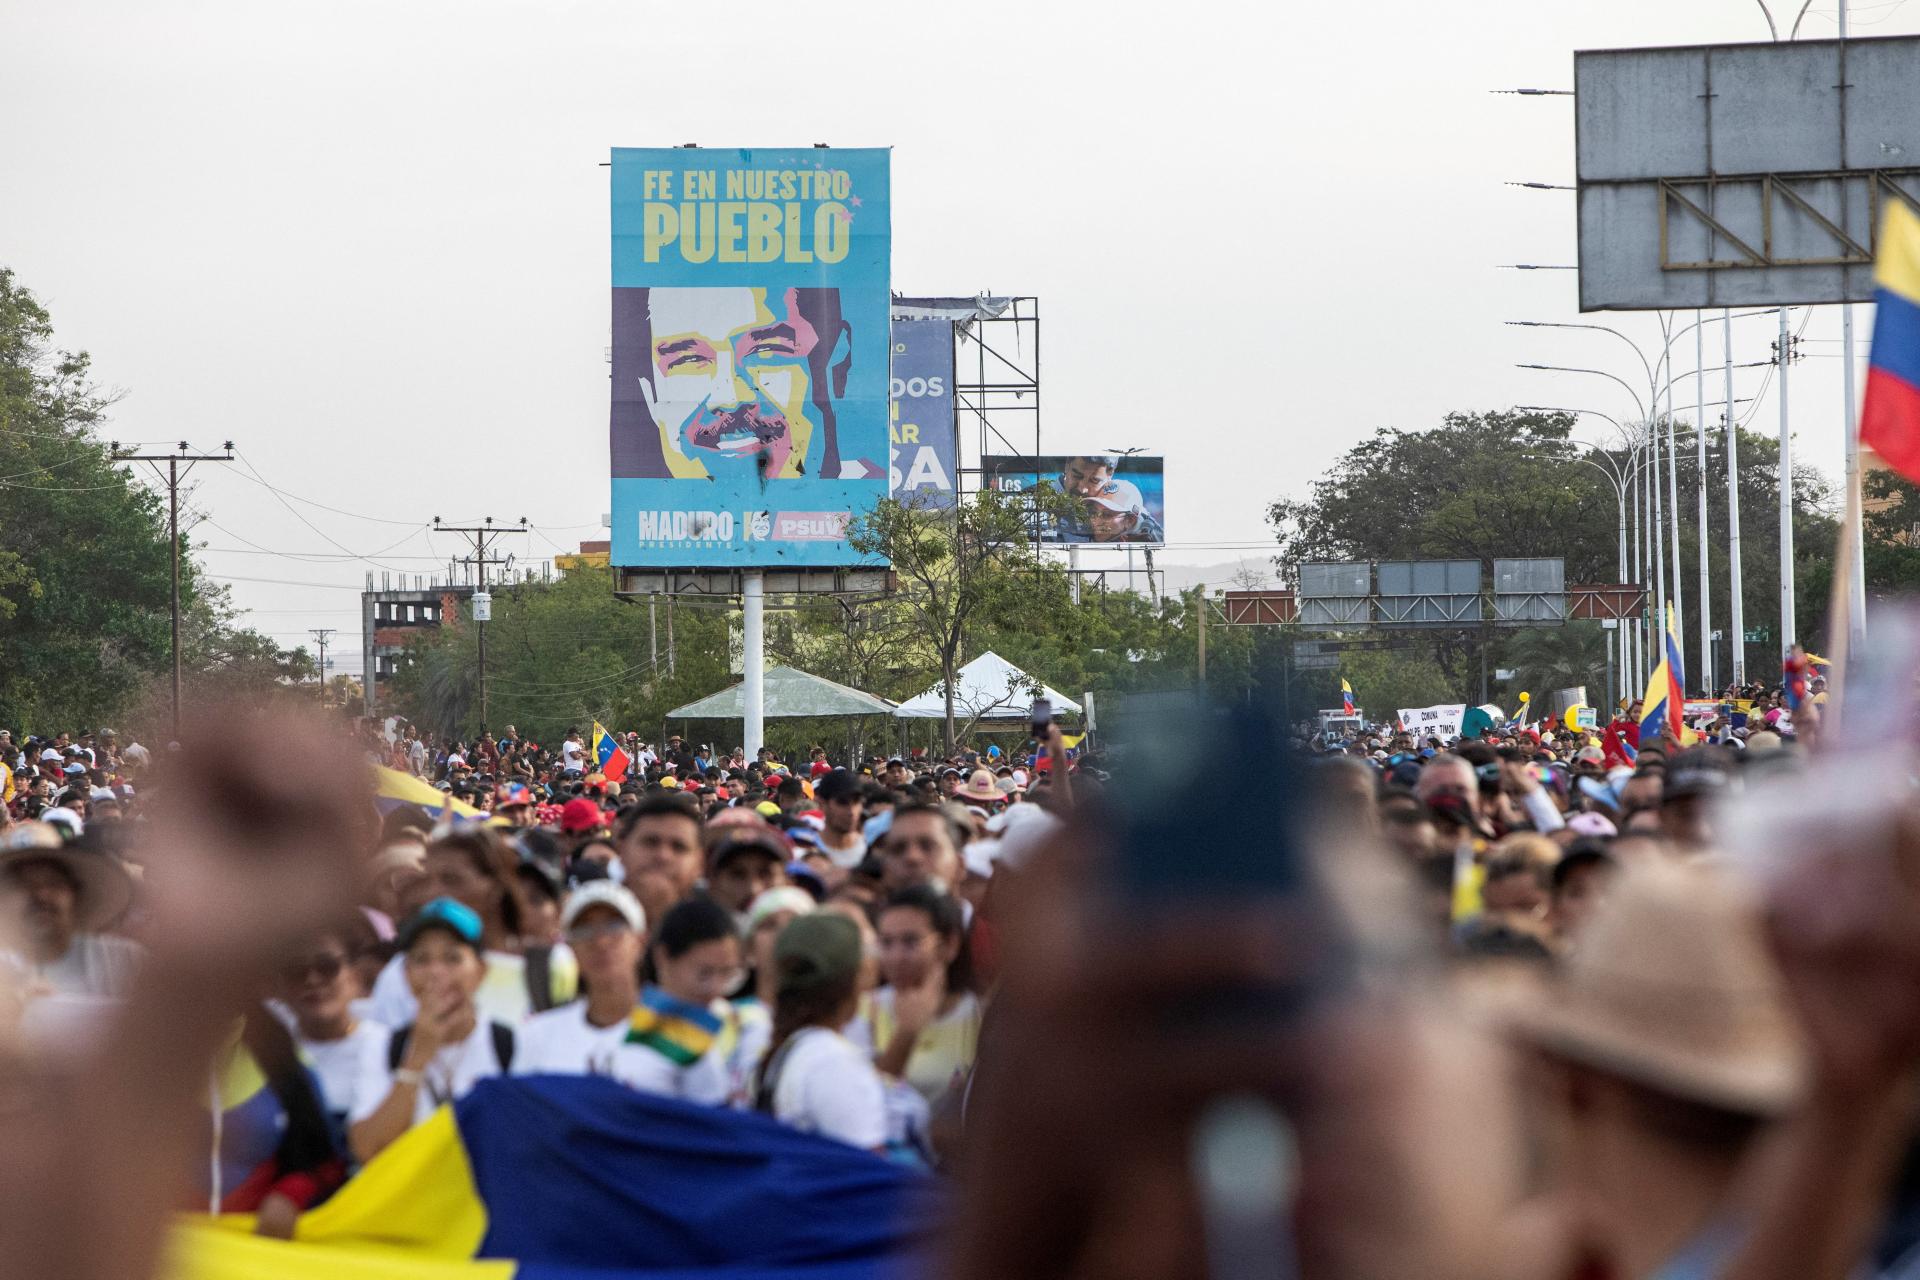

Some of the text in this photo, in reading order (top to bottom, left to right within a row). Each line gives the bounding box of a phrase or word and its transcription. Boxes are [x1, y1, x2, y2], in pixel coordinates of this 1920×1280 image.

[644, 170, 849, 199] FE EN NUESTRO
[644, 202, 849, 264] PUEBLO
[639, 511, 734, 541] MADURO
[781, 519, 841, 536] PSUV
[639, 541, 733, 549] PRESIDENTE
[1421, 711, 1438, 721] COMUNA
[1425, 726, 1436, 735] DE
[1440, 722, 1455, 735] TIMÓN
